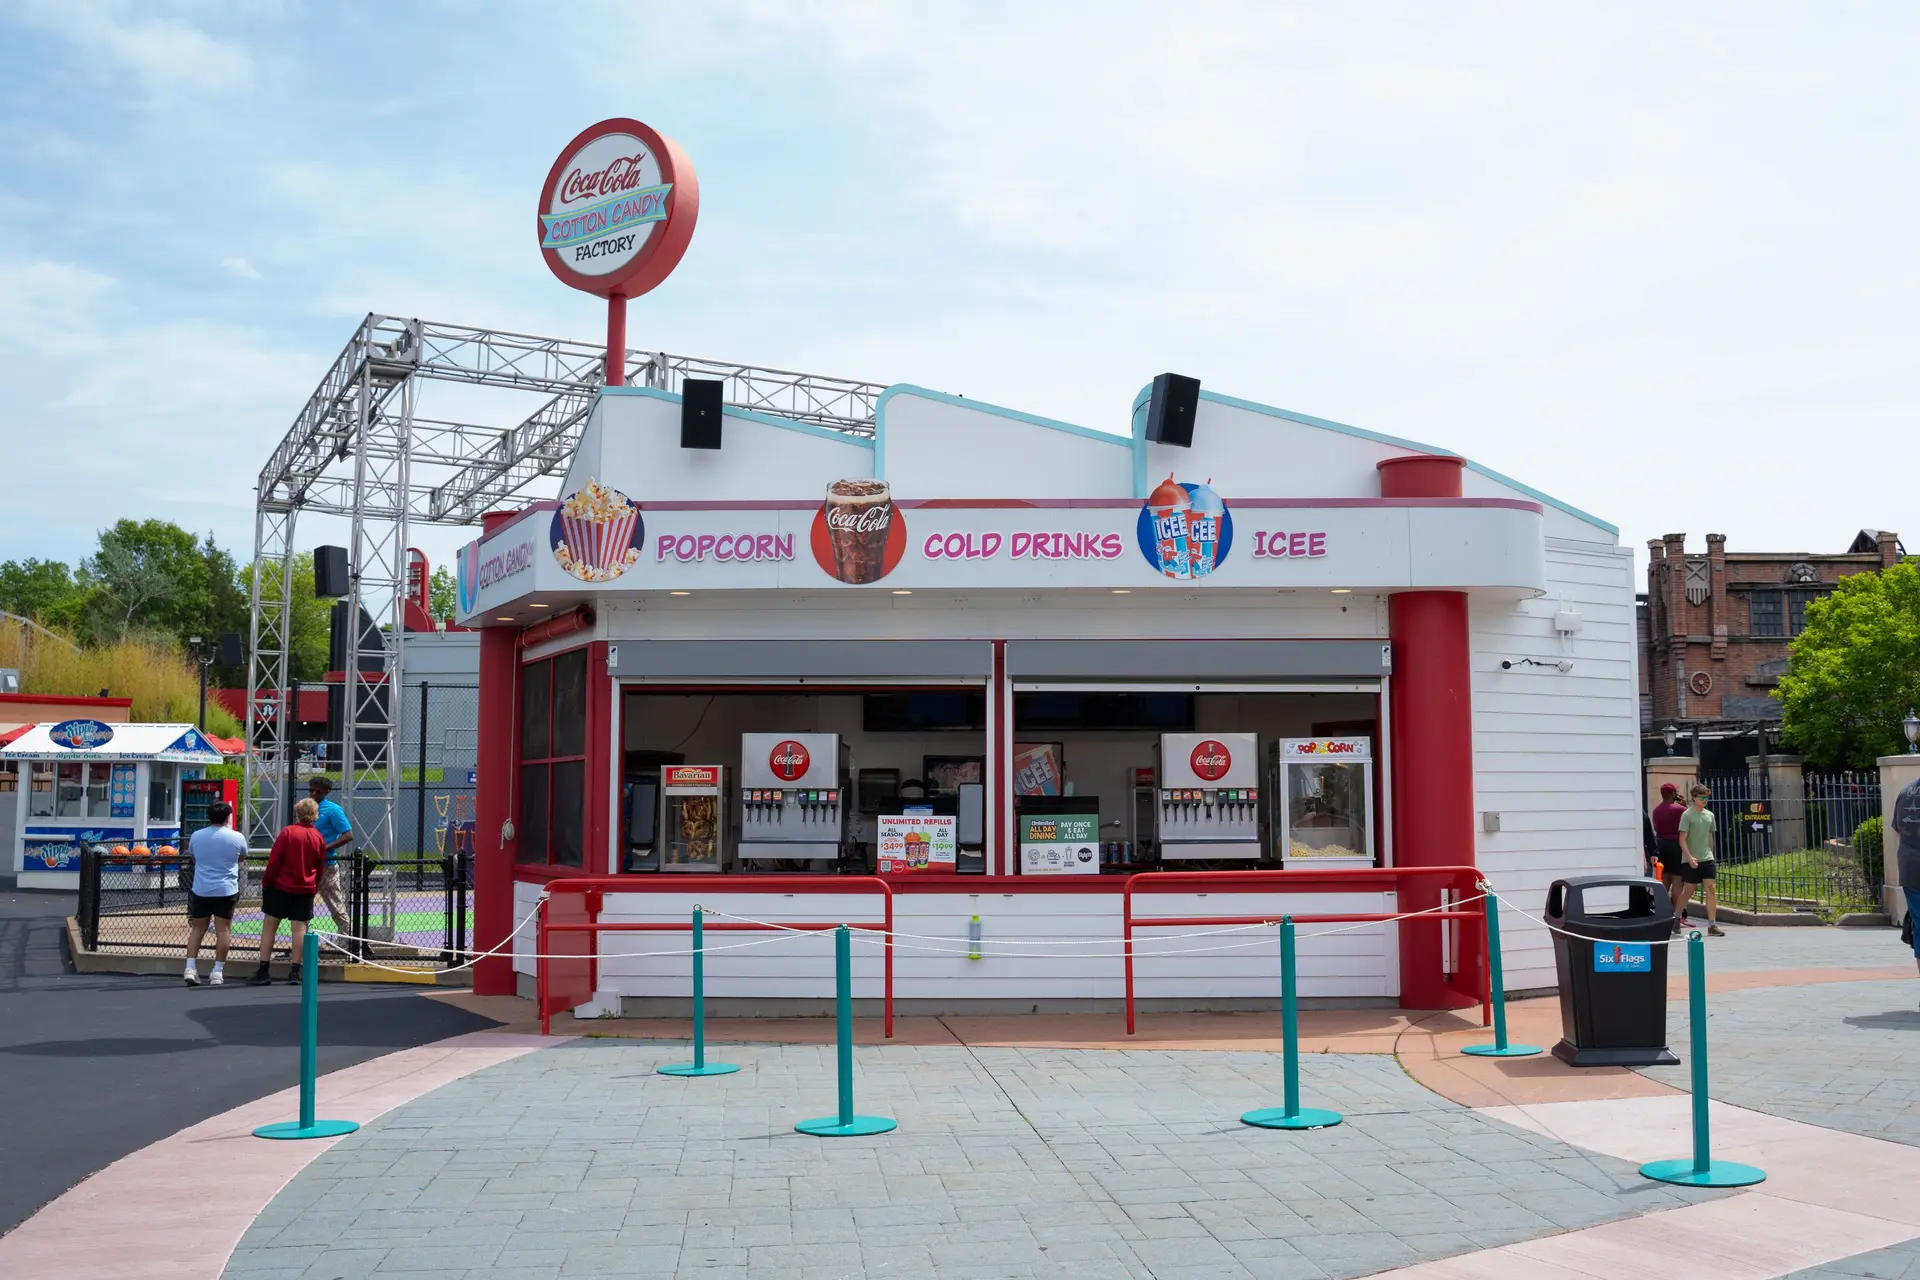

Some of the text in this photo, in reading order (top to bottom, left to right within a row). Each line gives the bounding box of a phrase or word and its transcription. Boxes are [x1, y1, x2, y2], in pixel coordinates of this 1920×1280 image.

[561, 152, 646, 204] Coca-Cola
[551, 192, 664, 240] COTTON CANDY
[575, 234, 636, 261] FACTORY
[827, 504, 890, 533] Coca-Cola
[1154, 515, 1188, 541] ICEE
[1191, 521, 1216, 542] CEE
[656, 532, 795, 562] POPCORN
[923, 530, 1123, 560] COLD DRINKS
[1253, 530, 1328, 558] ICEE
[479, 540, 533, 587] COTTON CANDY
[774, 754, 805, 765] Coca-Cola
[1298, 741, 1354, 753] POP CORN
[1196, 755, 1227, 766] Coca-Cola
[673, 771, 711, 779] Bavarian
[1029, 832, 1057, 840] DINING
[1599, 953, 1645, 965] Six Flags
